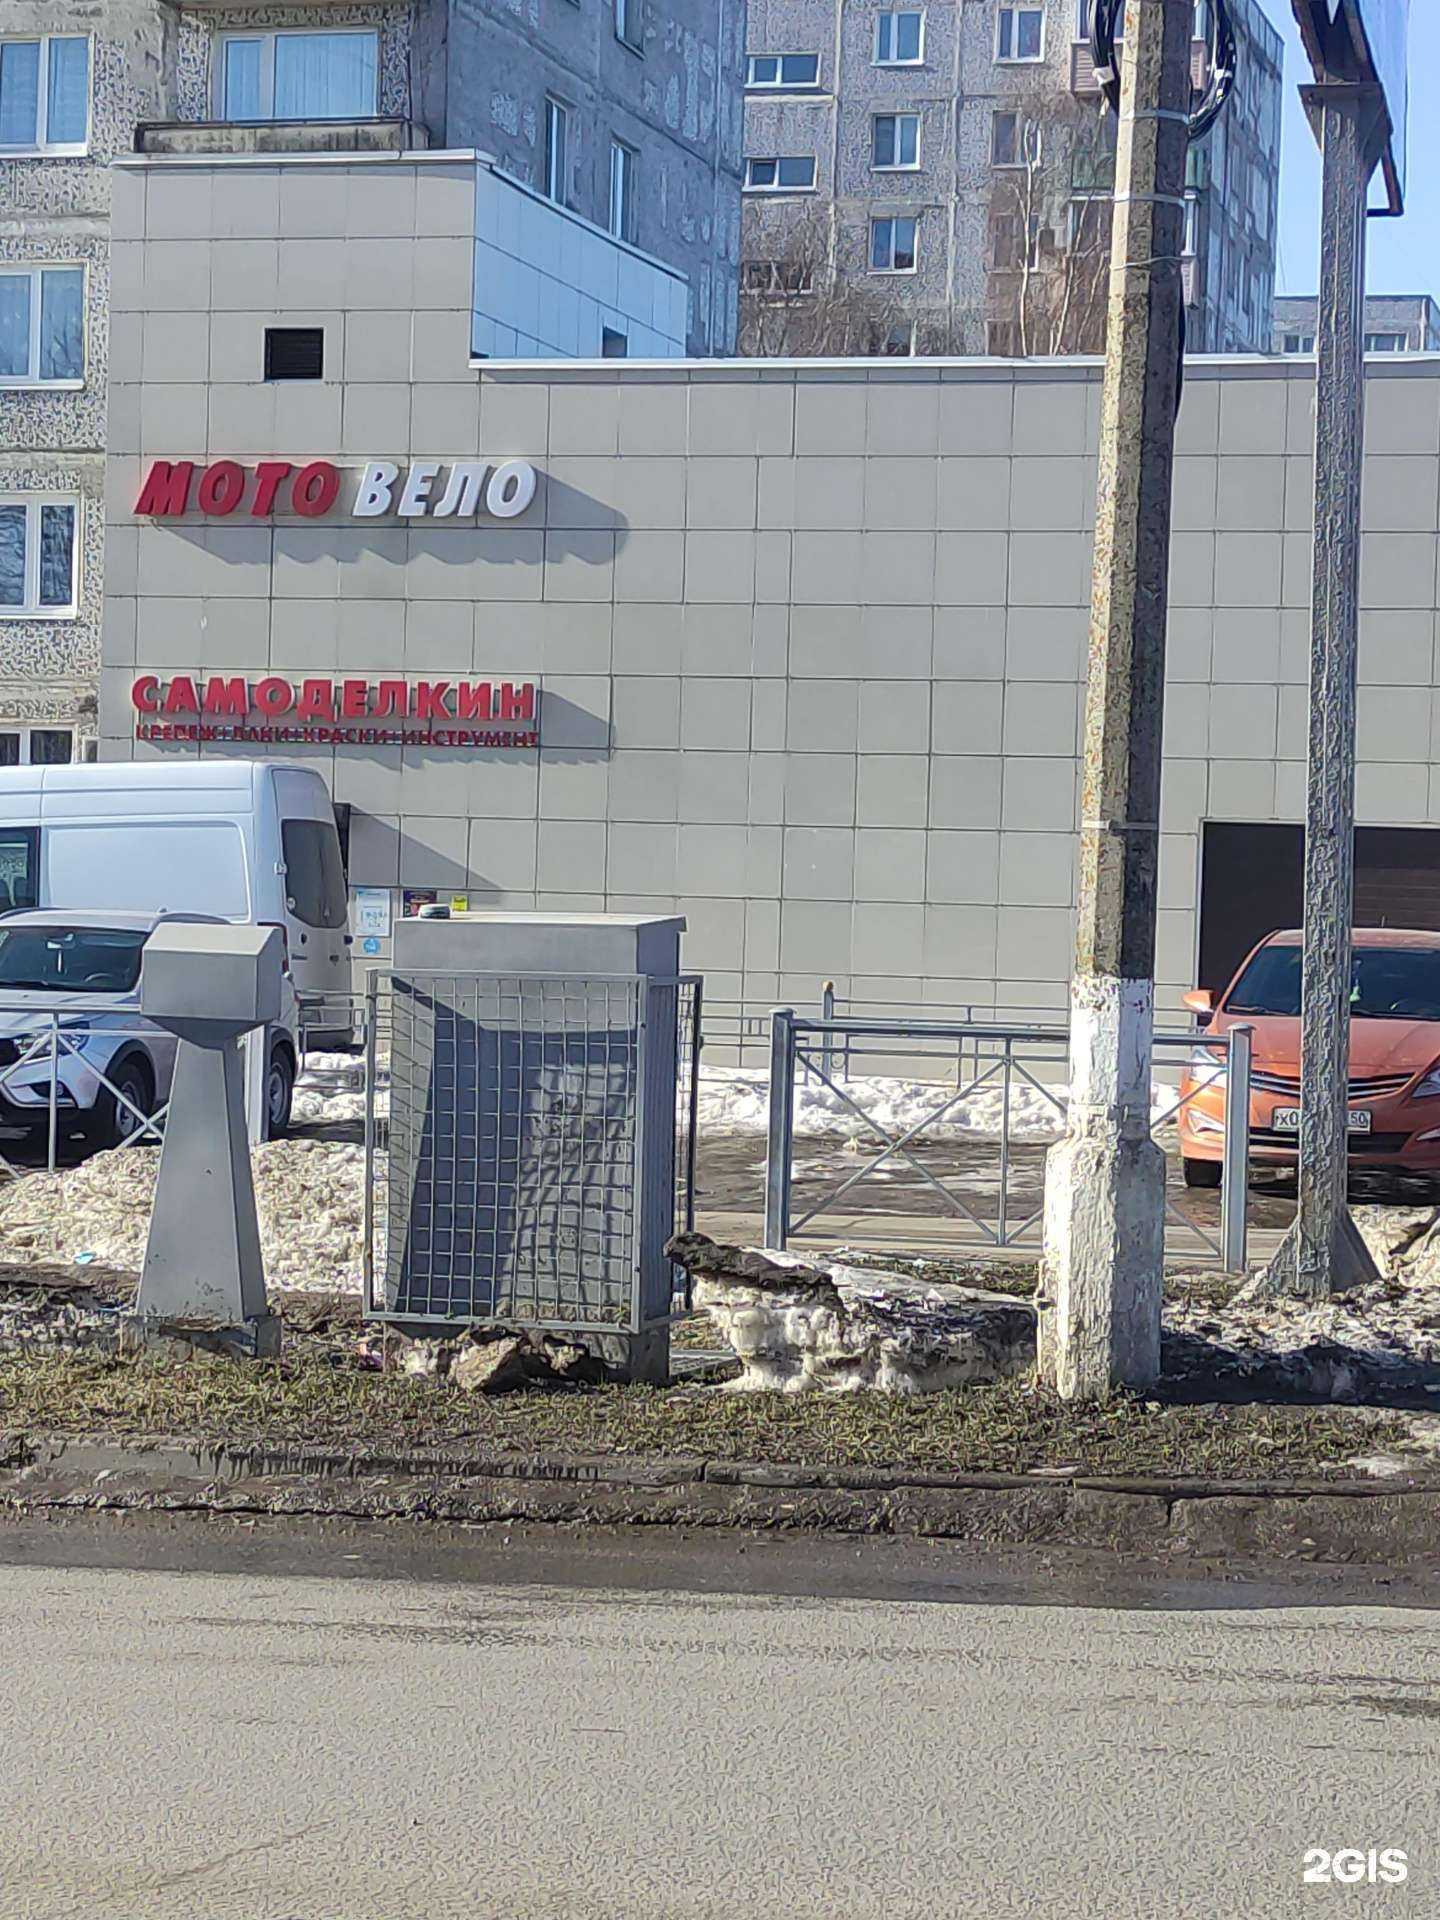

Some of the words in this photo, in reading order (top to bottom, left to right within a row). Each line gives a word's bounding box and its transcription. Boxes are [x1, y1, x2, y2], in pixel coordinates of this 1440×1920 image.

[134, 460, 341, 517] МОТО
[351, 460, 538, 518] ВЕЛО
[132, 675, 535, 722] САМОДЕЛКИН
